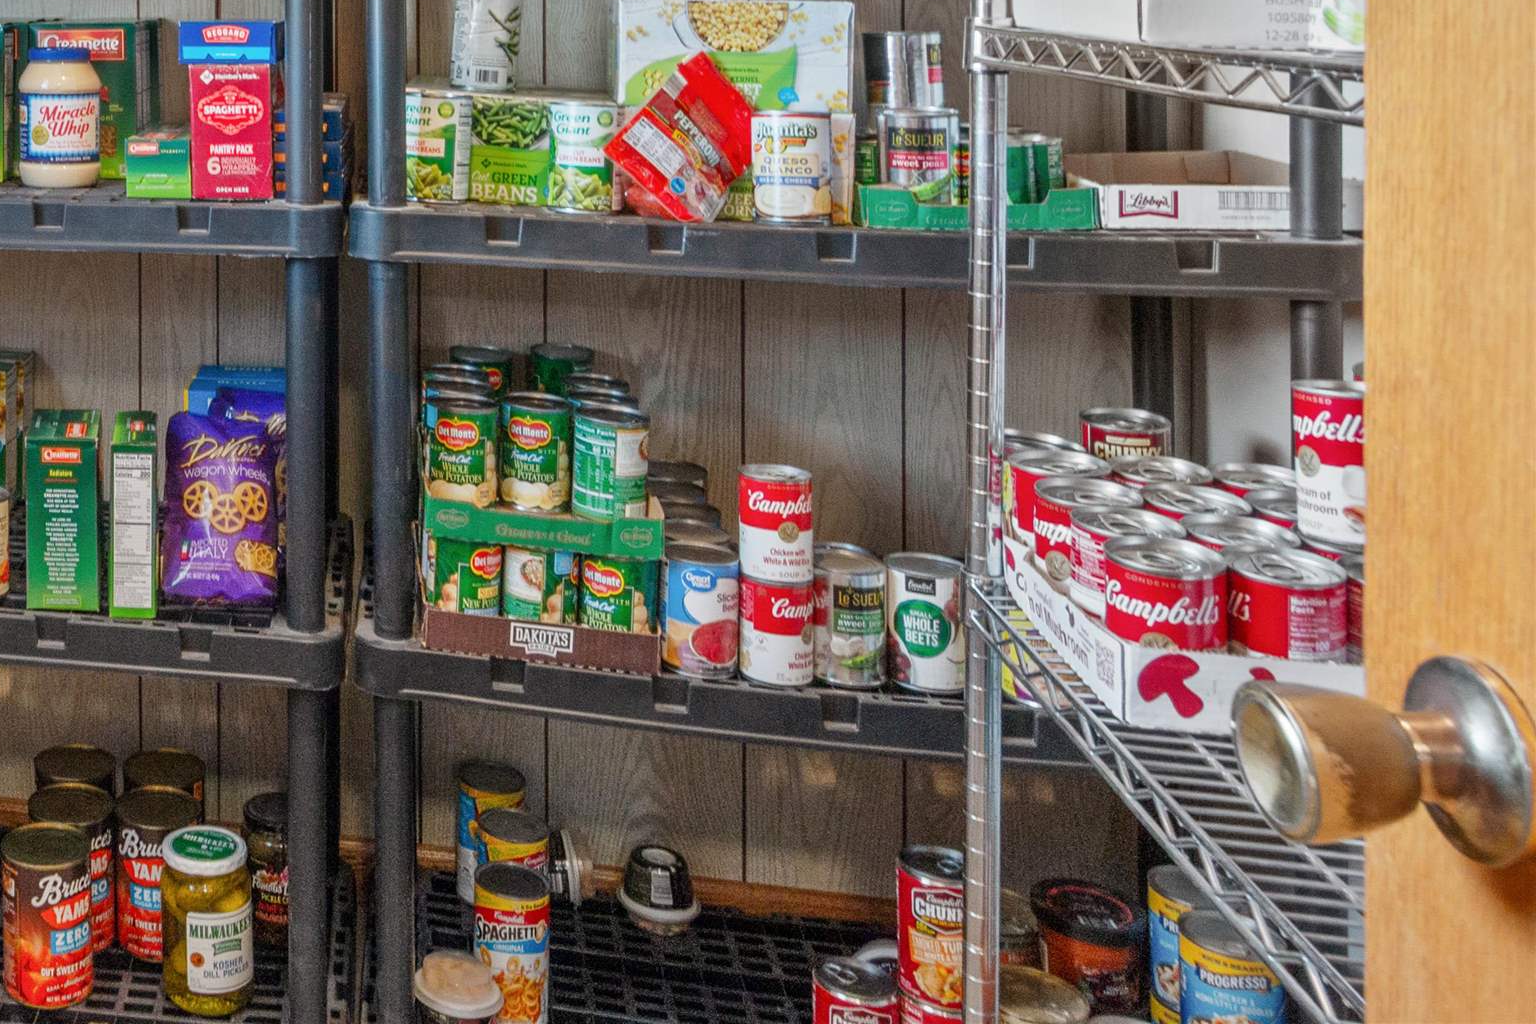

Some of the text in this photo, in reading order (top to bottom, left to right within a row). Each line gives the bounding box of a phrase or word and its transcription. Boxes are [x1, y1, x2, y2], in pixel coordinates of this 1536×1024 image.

[39, 101, 96, 124] Miracle
[204, 104, 258, 115] SPAGHETTI
[48, 120, 90, 139] Whip
[904, 130, 945, 148] SUEUR
[210, 143, 254, 155] PANTRY PACK
[207, 157, 222, 176] 6
[492, 172, 538, 185] GREEN
[471, 183, 538, 203] BEANS
[1126, 192, 1170, 210] Libby's
[438, 427, 476, 438] Del Monte
[510, 427, 548, 439] Del Monte
[181, 433, 266, 469] DaVinci
[184, 464, 268, 482] wagon wheels
[442, 462, 469, 472] WHOLE
[514, 461, 541, 472] WHOLE
[445, 471, 483, 484] POTATOES
[517, 471, 555, 484] POTATOES
[1320, 490, 1332, 500] of
[770, 548, 794, 558] Chicken
[473, 556, 485, 568] Del
[763, 556, 782, 566] White
[594, 572, 621, 587] Monte
[1106, 574, 1220, 626] Campbell's
[909, 609, 933, 619] SMALL
[903, 614, 941, 634] WHOLE
[516, 628, 569, 646] DAKOTA'S
[905, 629, 939, 647] BEETS
[119, 828, 164, 859] Bruc
[53, 895, 90, 925] YAMS
[55, 923, 90, 945] ZERO
[493, 943, 525, 954] ORIGINAL
[56, 964, 79, 977] SWEET
[213, 956, 244, 971] KOSHER
[1199, 970, 1269, 990] PROGRESSO
